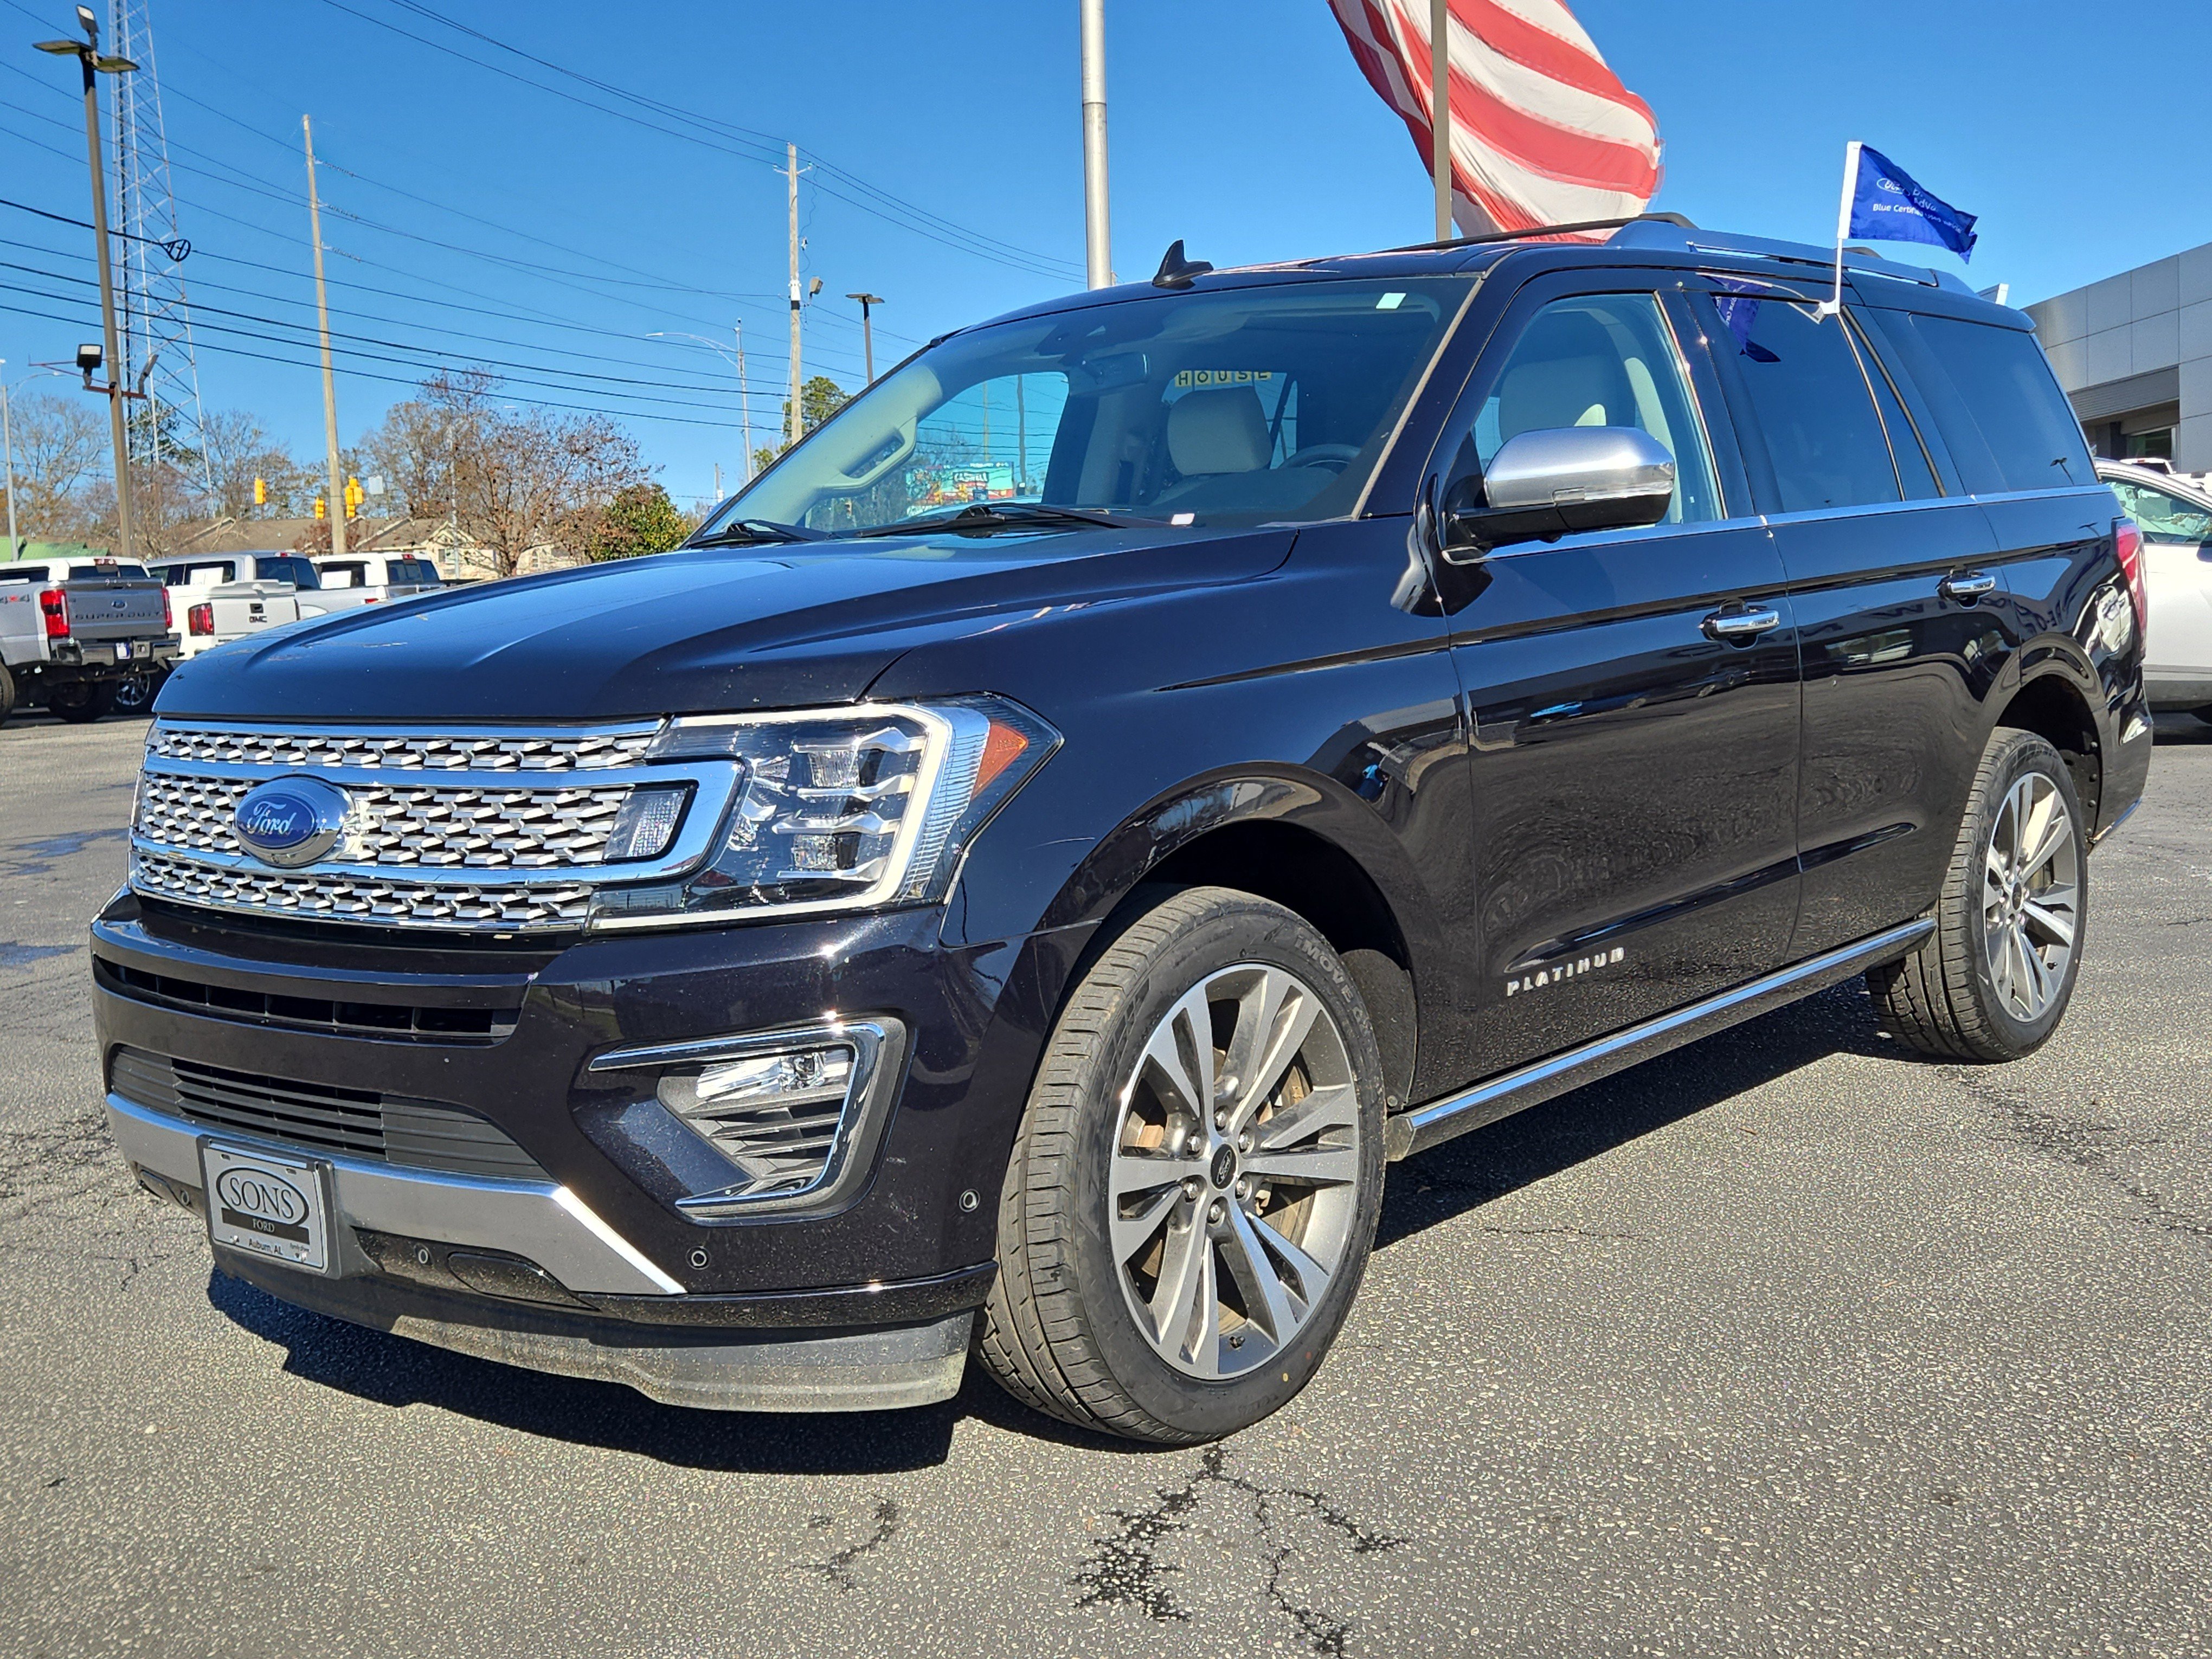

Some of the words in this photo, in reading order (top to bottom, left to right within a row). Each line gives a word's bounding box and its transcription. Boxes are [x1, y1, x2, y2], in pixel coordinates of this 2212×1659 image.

[1873, 203, 1891, 211] Blue
[247, 801, 297, 835] Ford
[1507, 947, 1625, 996] PLATINUM
[230, 1177, 294, 1219] SONS
[252, 1218, 275, 1232] FORD
[274, 1245, 284, 1255] AL
